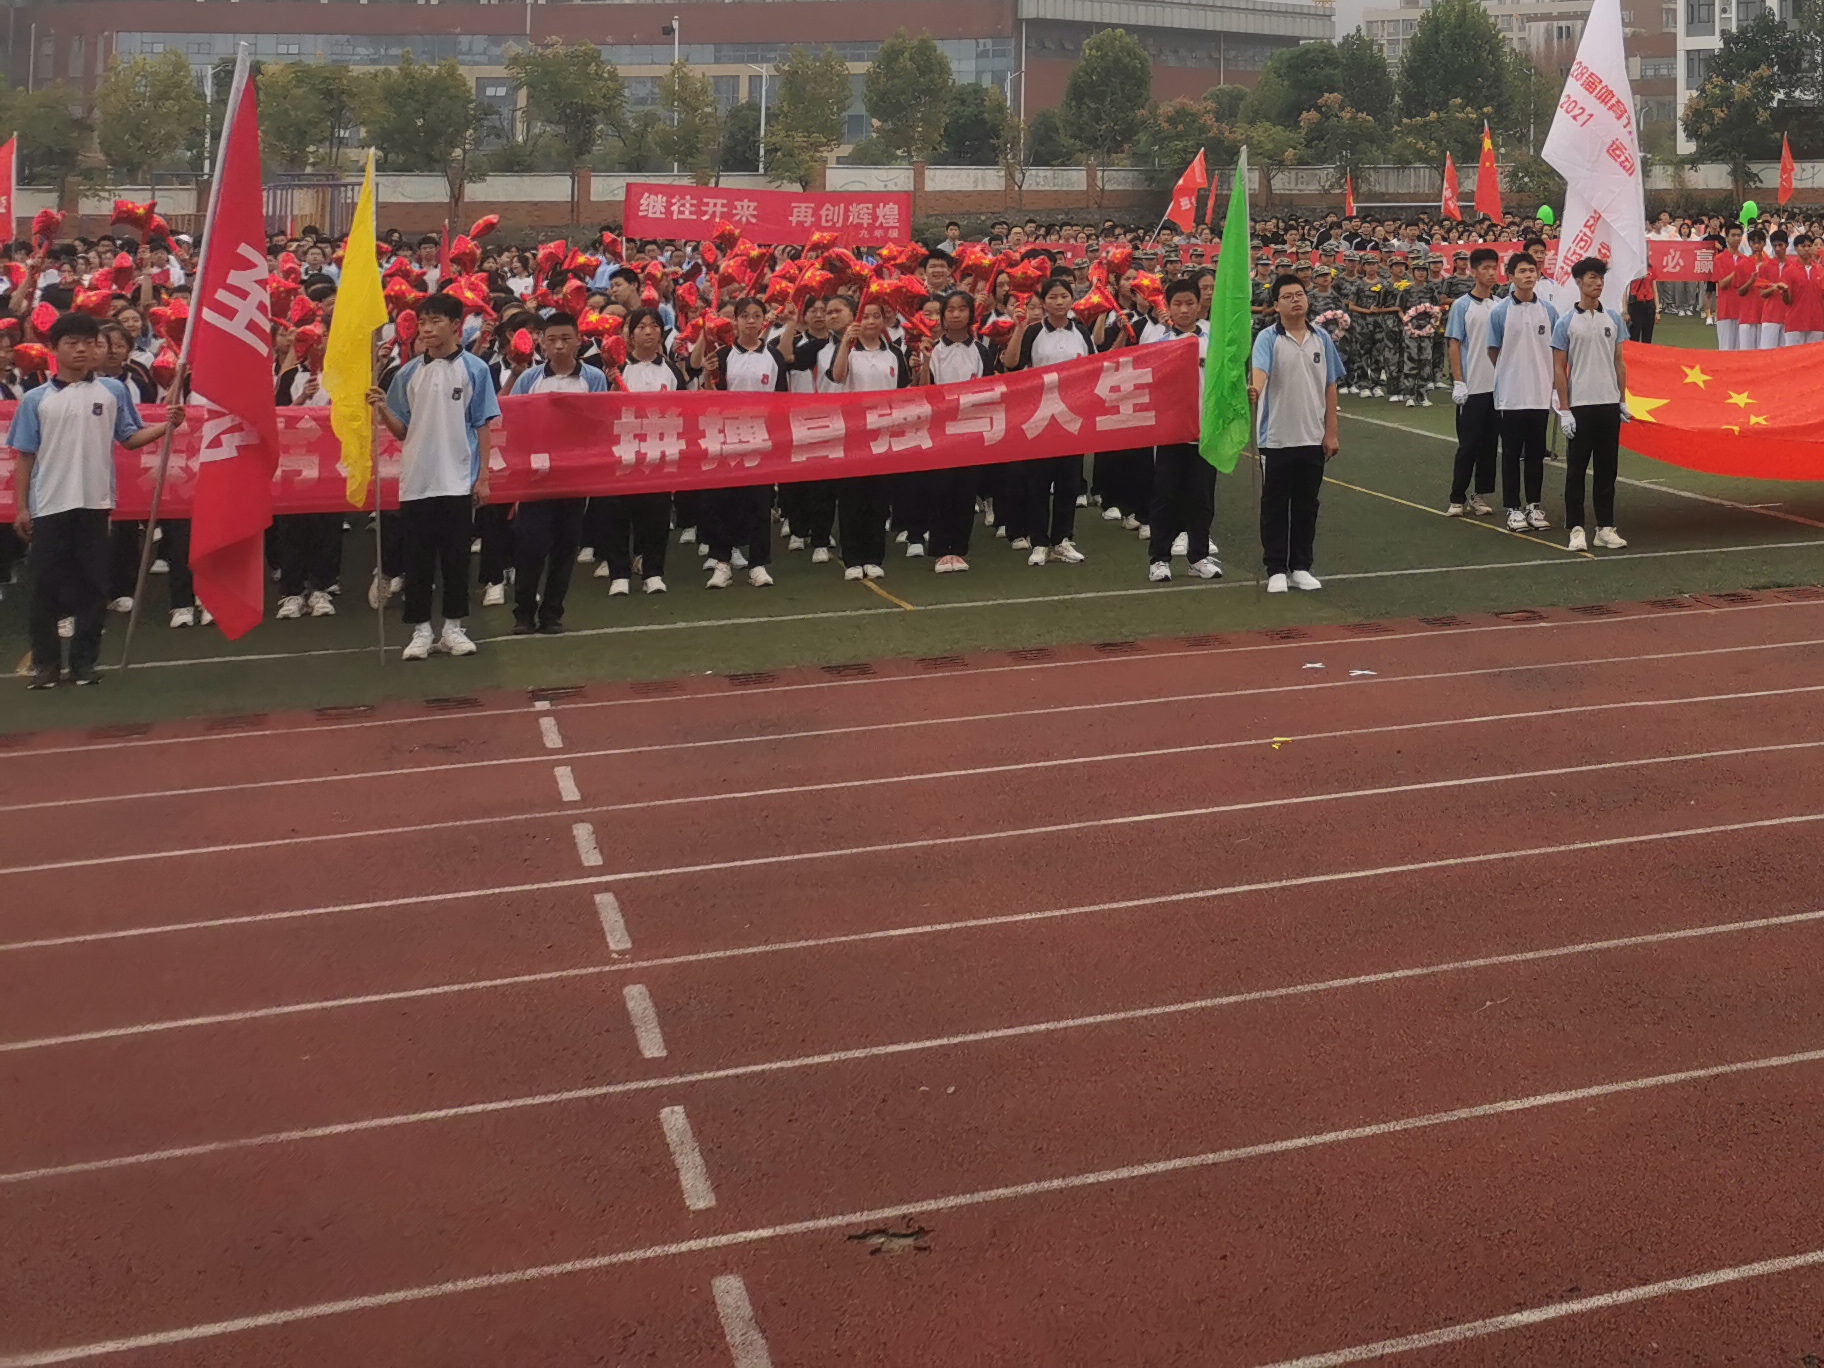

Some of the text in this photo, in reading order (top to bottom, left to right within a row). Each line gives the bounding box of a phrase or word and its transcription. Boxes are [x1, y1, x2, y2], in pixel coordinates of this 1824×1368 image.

[639, 192, 900, 229] 继往开来 再创辉煌
